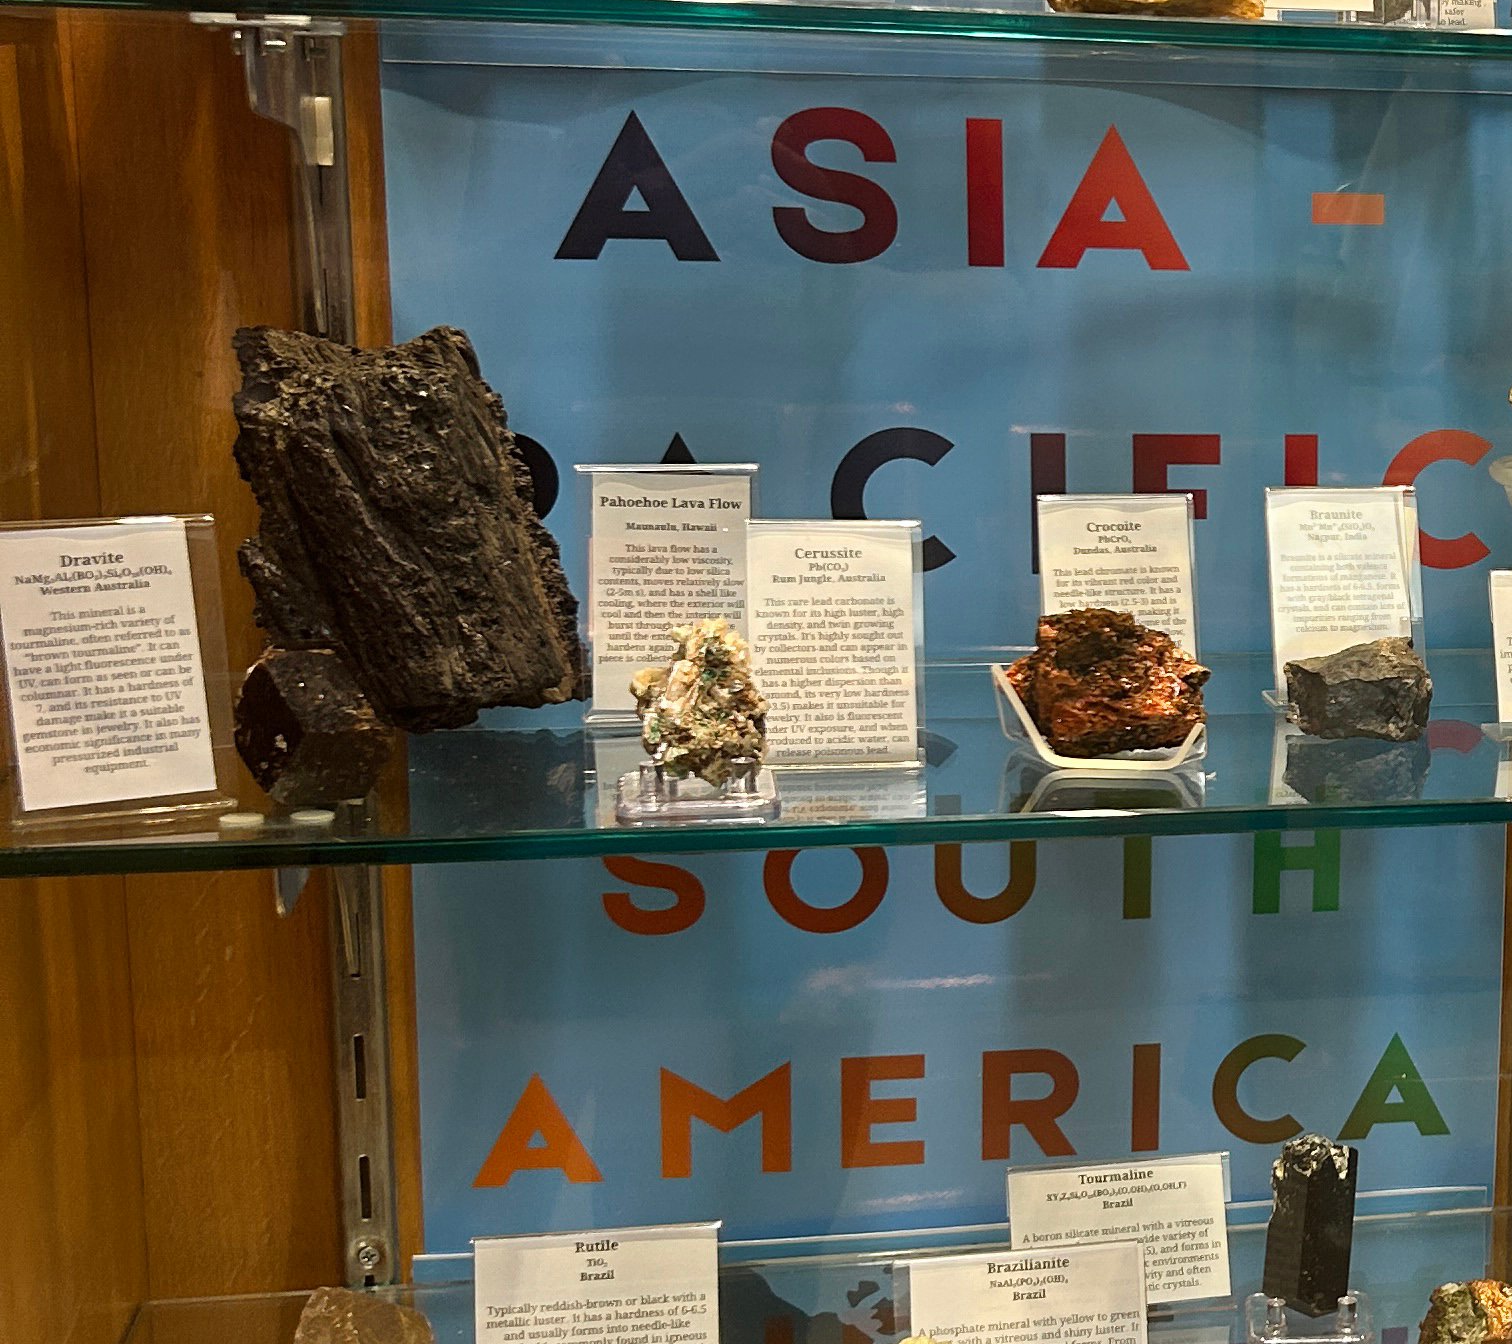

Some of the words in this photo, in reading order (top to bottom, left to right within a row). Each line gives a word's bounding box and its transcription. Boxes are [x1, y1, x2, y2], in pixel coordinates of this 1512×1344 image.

[554, 106, 1192, 271] ASIA
[600, 497, 668, 509] Pahoehoe
[672, 498, 704, 509] Lava
[709, 498, 740, 510] Flow
[1309, 508, 1362, 520] Braunite
[1086, 521, 1141, 532] Crocoite
[795, 548, 861, 559] Cerussite
[1114, 544, 1156, 554] Australia
[60, 552, 123, 567] Dravite
[837, 573, 885, 583] Australia
[94, 580, 150, 591] Australia
[473, 1033, 1450, 1188] AMERICA
[1078, 1169, 1153, 1184] Tourmaline
[1102, 1198, 1132, 1209] Brazil
[575, 1240, 618, 1252] Rutile
[987, 1256, 1069, 1274] Brazilianite
[579, 1270, 614, 1281] Brazil
[1012, 1290, 1046, 1301] Brazil
[487, 1303, 538, 1318] Typically
[539, 1297, 622, 1312] reddish-brown
[625, 1297, 638, 1307] or
[640, 1294, 669, 1305] black
[672, 1291, 696, 1303] with
[699, 1293, 705, 1301] a
